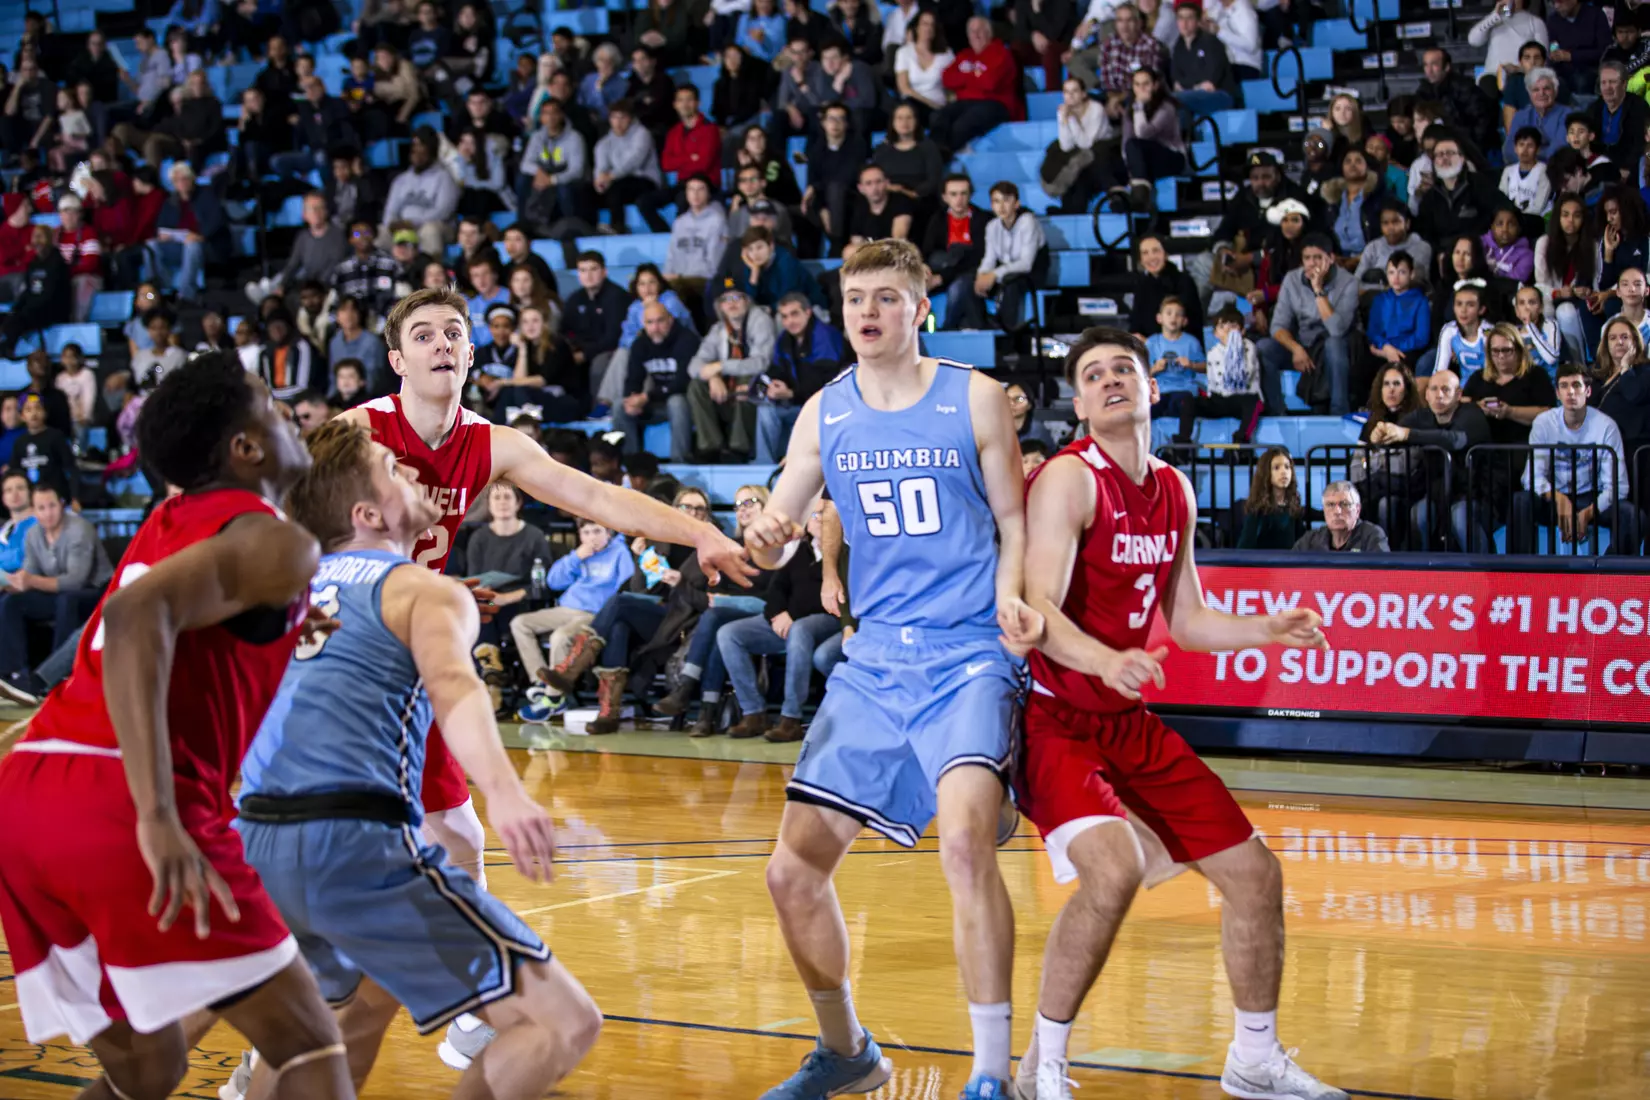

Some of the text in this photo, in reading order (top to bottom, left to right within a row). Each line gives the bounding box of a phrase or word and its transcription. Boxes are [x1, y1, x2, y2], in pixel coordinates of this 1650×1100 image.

[836, 448, 960, 472] COLUMBIA
[857, 476, 943, 537] 50
[1128, 573, 1156, 629] 3
[1314, 591, 1475, 631] YORK'S
[1488, 595, 1533, 633] #1
[1546, 597, 1650, 636] HOS
[1210, 648, 1267, 682] TO
[1278, 648, 1486, 690] SUPPORT
[1499, 655, 1588, 693] THE
[1268, 708, 1320, 718] DAKTRONICS
